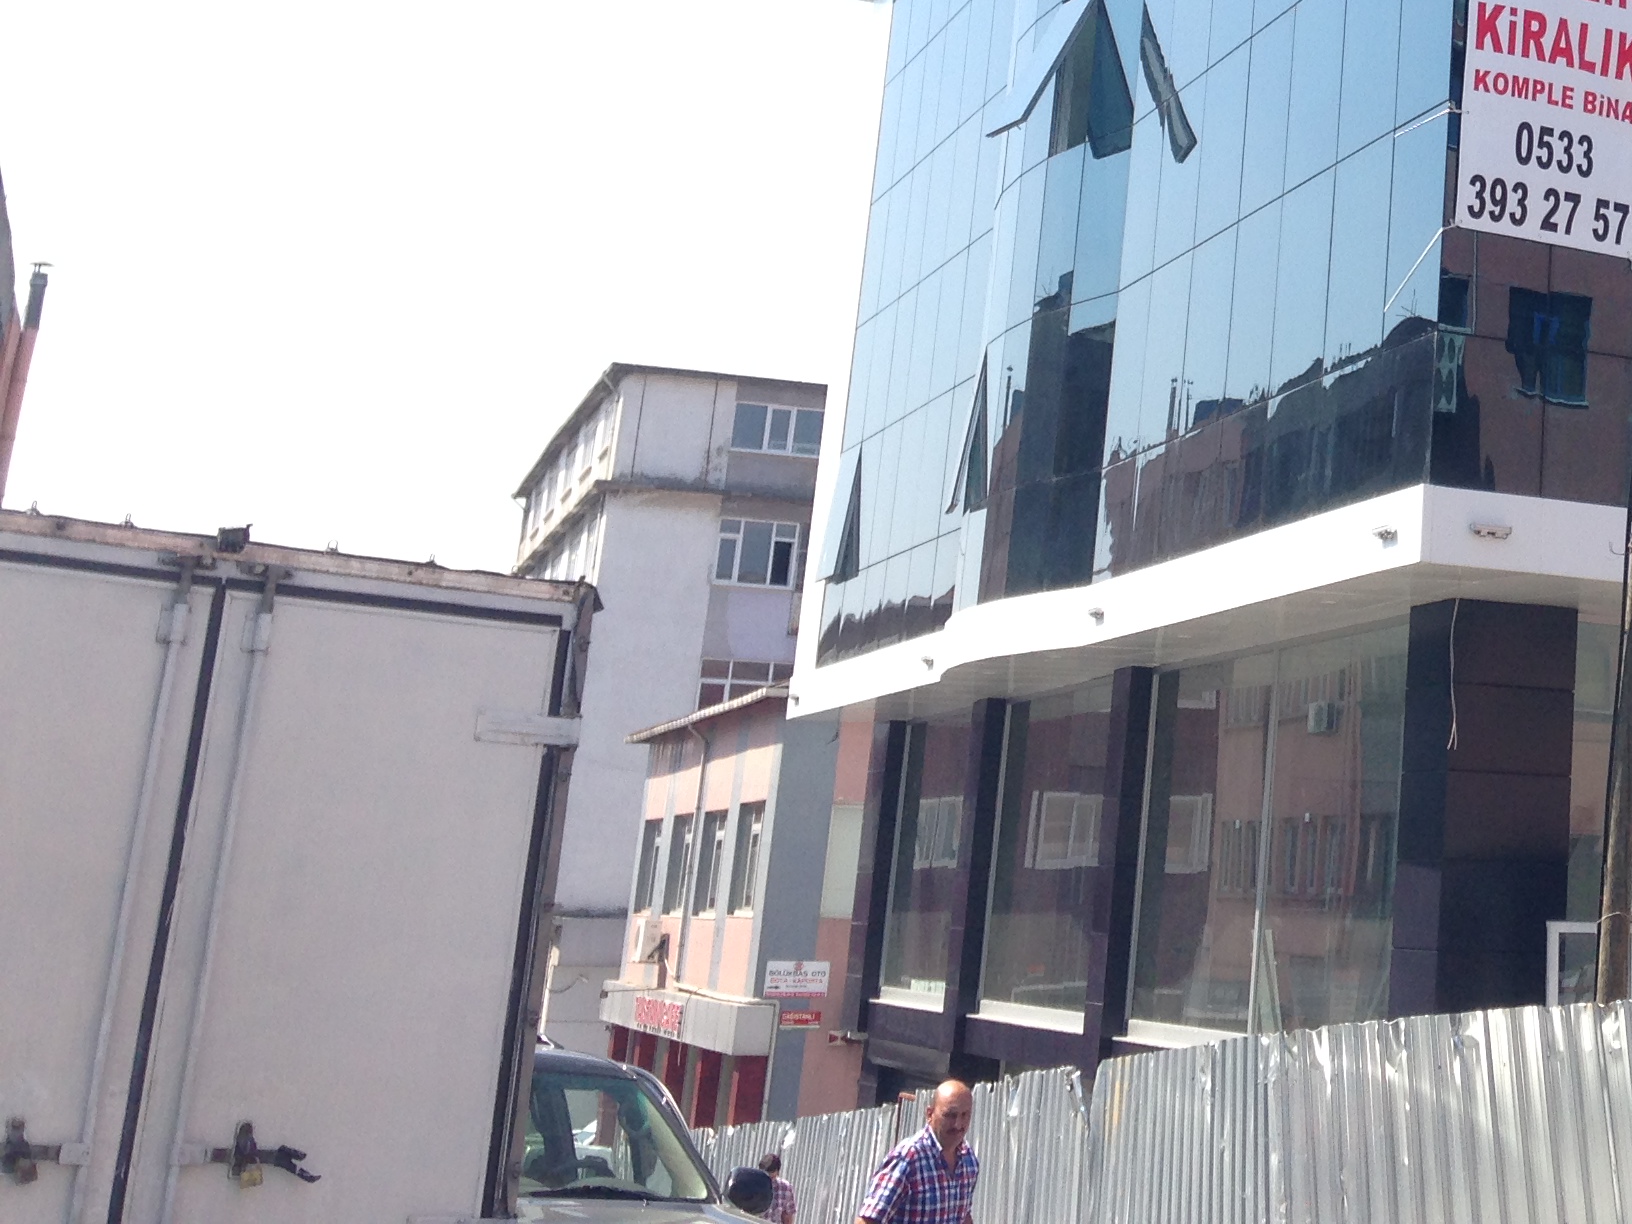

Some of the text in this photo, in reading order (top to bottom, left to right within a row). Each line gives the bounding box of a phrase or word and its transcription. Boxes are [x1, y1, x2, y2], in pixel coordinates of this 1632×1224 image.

[1473, 68, 1574, 110] KOMPLE
[1515, 121, 1594, 178] 0533
[1467, 174, 1631, 246] 393 27 57
